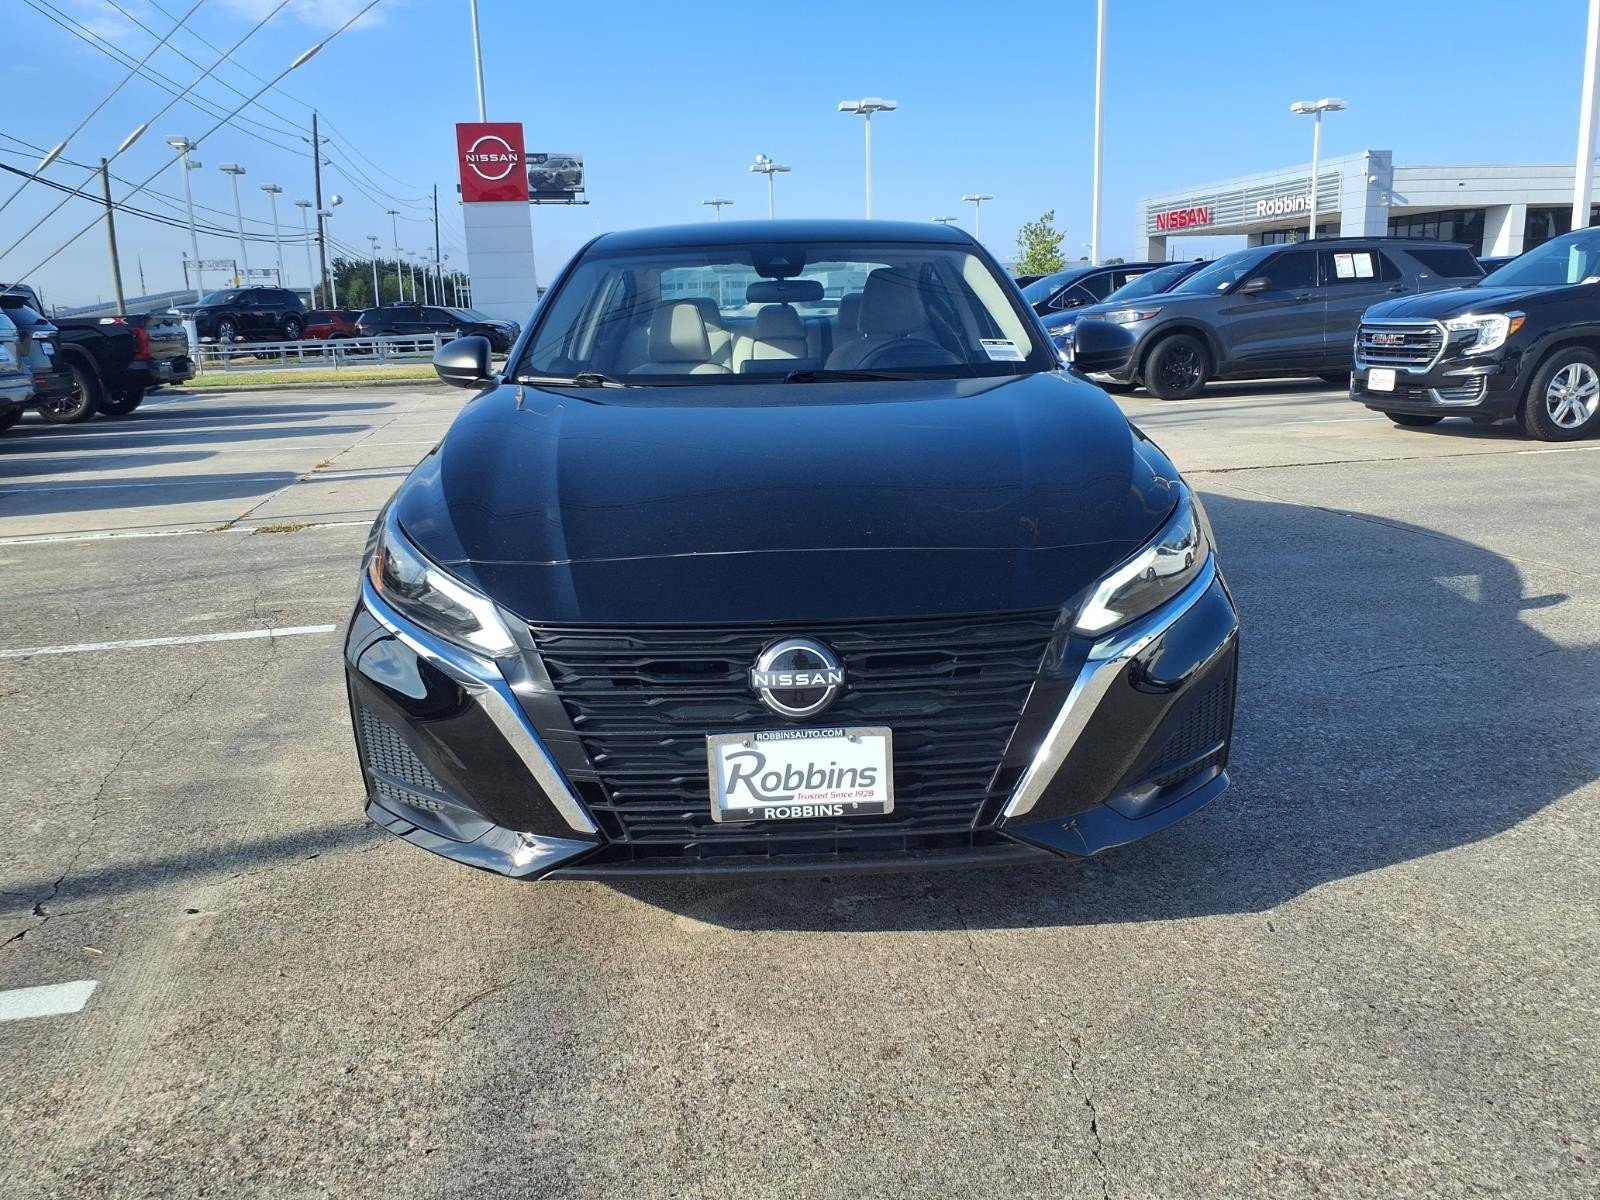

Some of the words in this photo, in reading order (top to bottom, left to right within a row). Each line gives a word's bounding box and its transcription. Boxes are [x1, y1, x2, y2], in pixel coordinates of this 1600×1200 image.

[465, 153, 518, 162] NISSAN
[1256, 194, 1312, 217] Robbins
[1156, 206, 1208, 231] NISSAN
[1371, 334, 1404, 344] GMC
[754, 671, 842, 686] NISSAN
[756, 729, 844, 741] ROBBINSAUTO.COM
[725, 750, 877, 802] Robbins
[797, 792, 829, 800] Trusted
[830, 791, 853, 799] Since
[855, 789, 875, 798] 1928
[764, 804, 844, 819] ROBBINS
